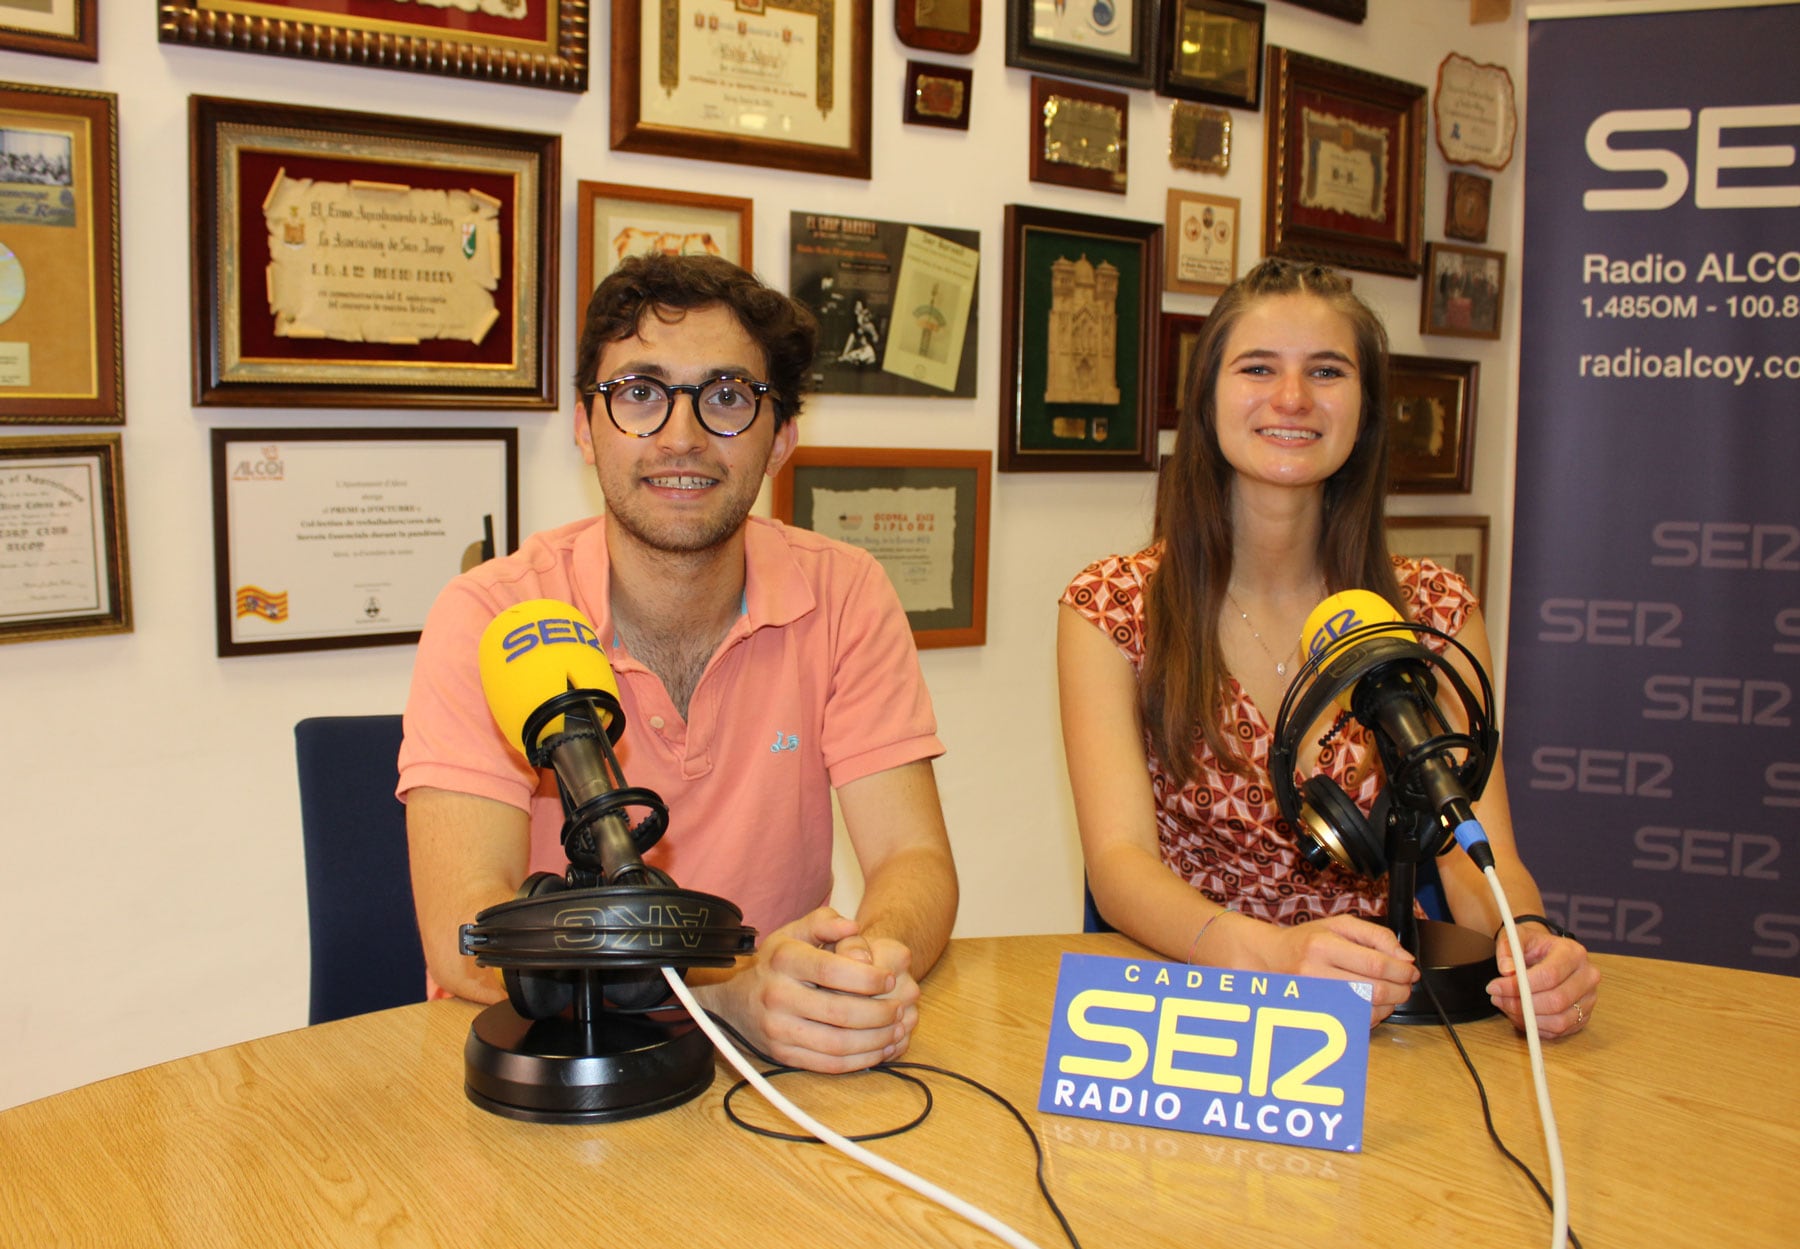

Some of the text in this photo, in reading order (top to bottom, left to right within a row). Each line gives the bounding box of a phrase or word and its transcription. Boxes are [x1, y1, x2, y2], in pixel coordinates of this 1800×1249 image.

[1583, 253, 1687, 284] Radio
[502, 618, 605, 664] SER
[1538, 598, 1683, 648] SER
[1642, 674, 1792, 727] SER
[1530, 746, 1674, 799] SER
[1632, 825, 1781, 880] SER
[553, 904, 709, 951] AKG
[1124, 964, 1300, 999] CADENA
[1059, 989, 1348, 1106] SER
[1054, 1079, 1342, 1141] RADIO ALCOY
